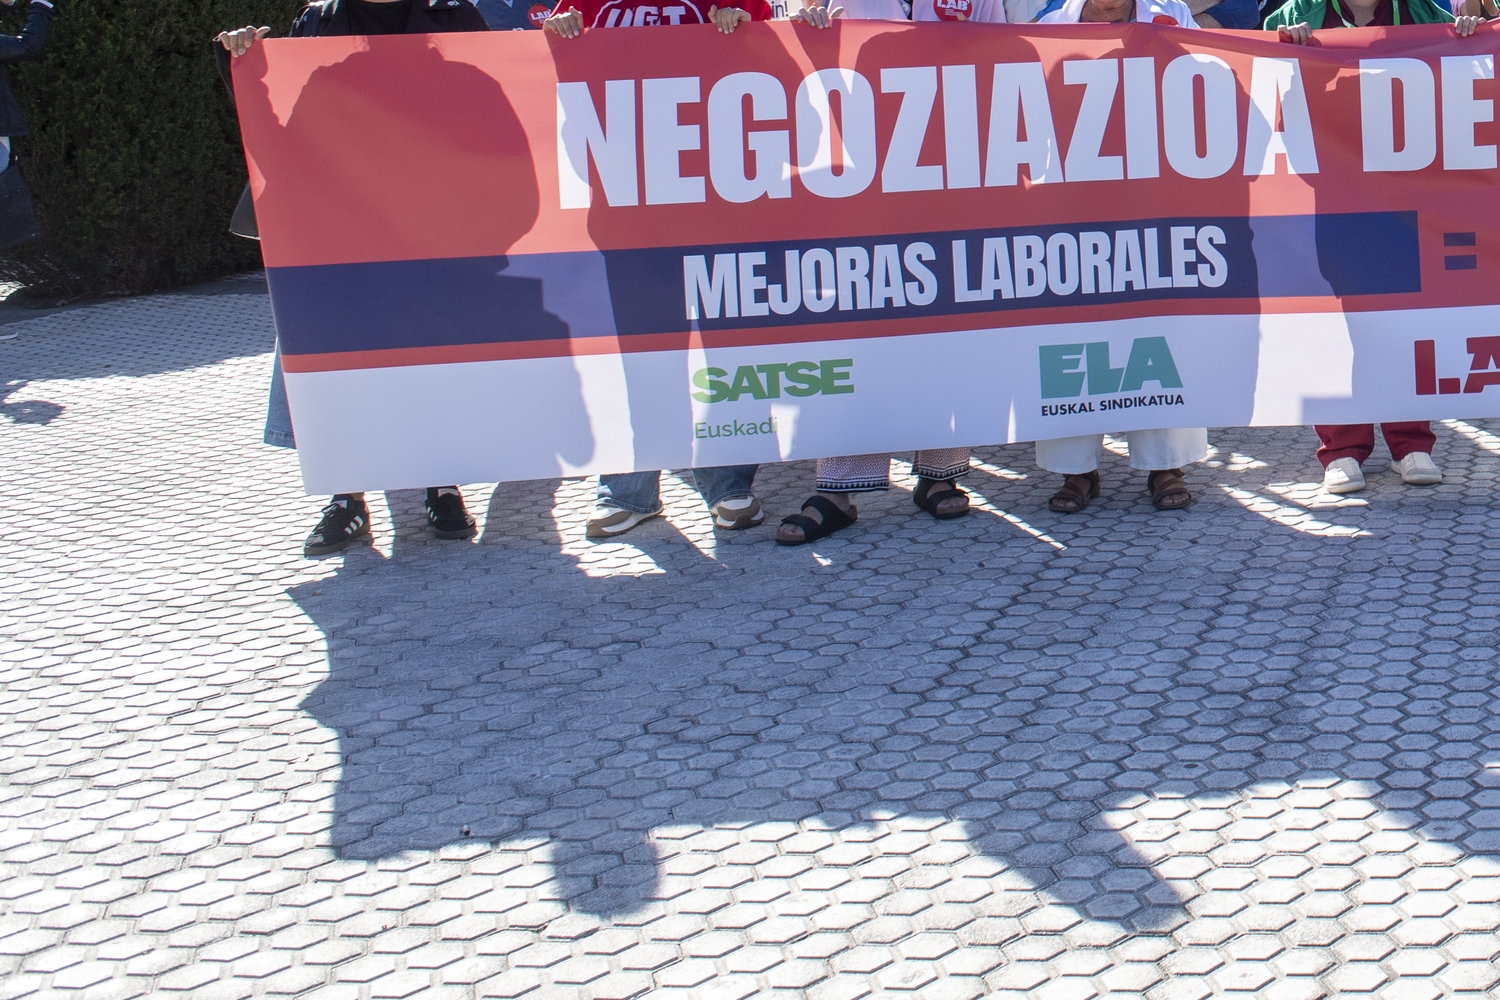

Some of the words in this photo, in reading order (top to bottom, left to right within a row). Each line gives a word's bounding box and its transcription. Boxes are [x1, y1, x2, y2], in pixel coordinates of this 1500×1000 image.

[604, 5, 687, 28] UGT
[556, 53, 1320, 209] NEGOZIAZIOA
[683, 241, 937, 320] MEJORAS
[952, 225, 1228, 303] LABORALES
[691, 358, 855, 403] SATSE
[1039, 336, 1184, 399] ELA
[694, 416, 778, 440] Euskadi
[1041, 402, 1096, 417] EUSKAL
[1099, 394, 1184, 413] SINDIKATUA
